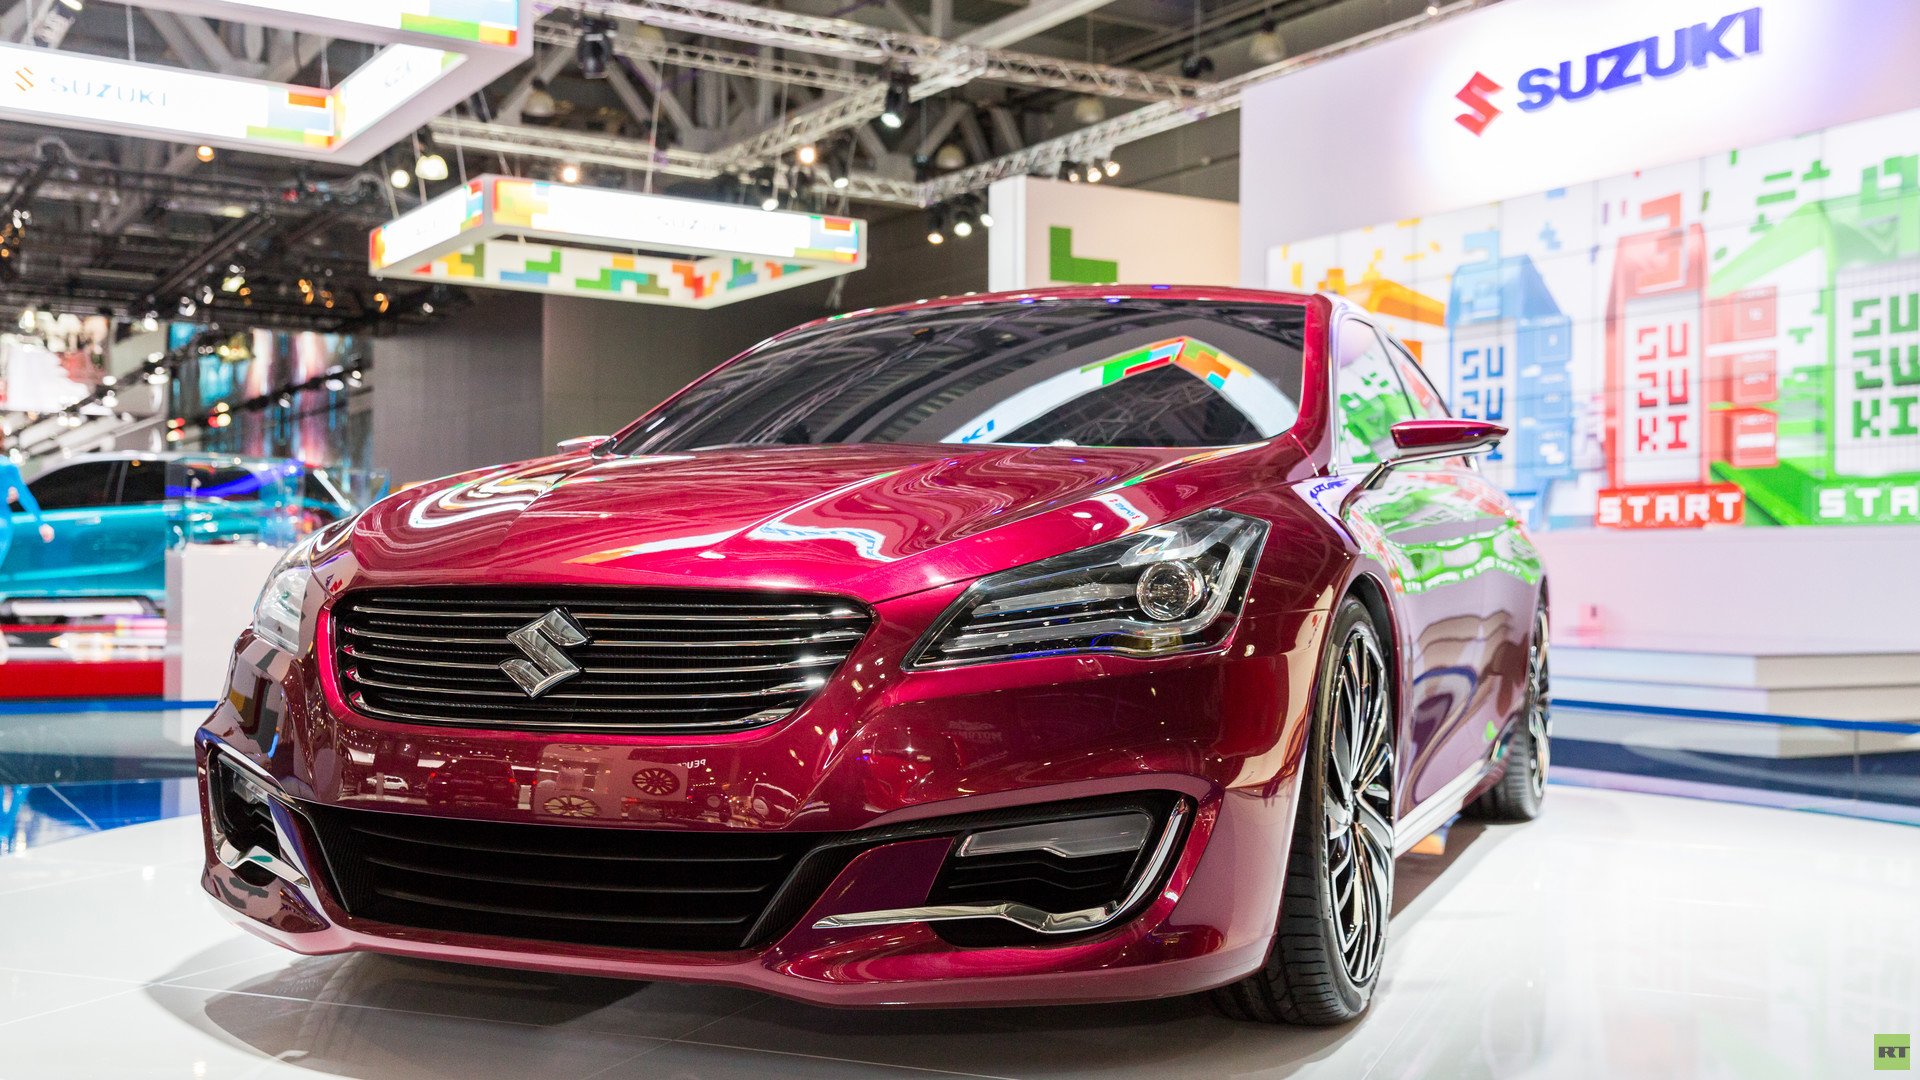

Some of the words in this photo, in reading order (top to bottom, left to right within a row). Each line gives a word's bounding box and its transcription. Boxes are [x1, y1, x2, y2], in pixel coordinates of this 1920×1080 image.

[1517, 7, 1762, 112] SUZUKI
[50, 76, 167, 107] SUZUKI
[1598, 492, 1742, 525] START
